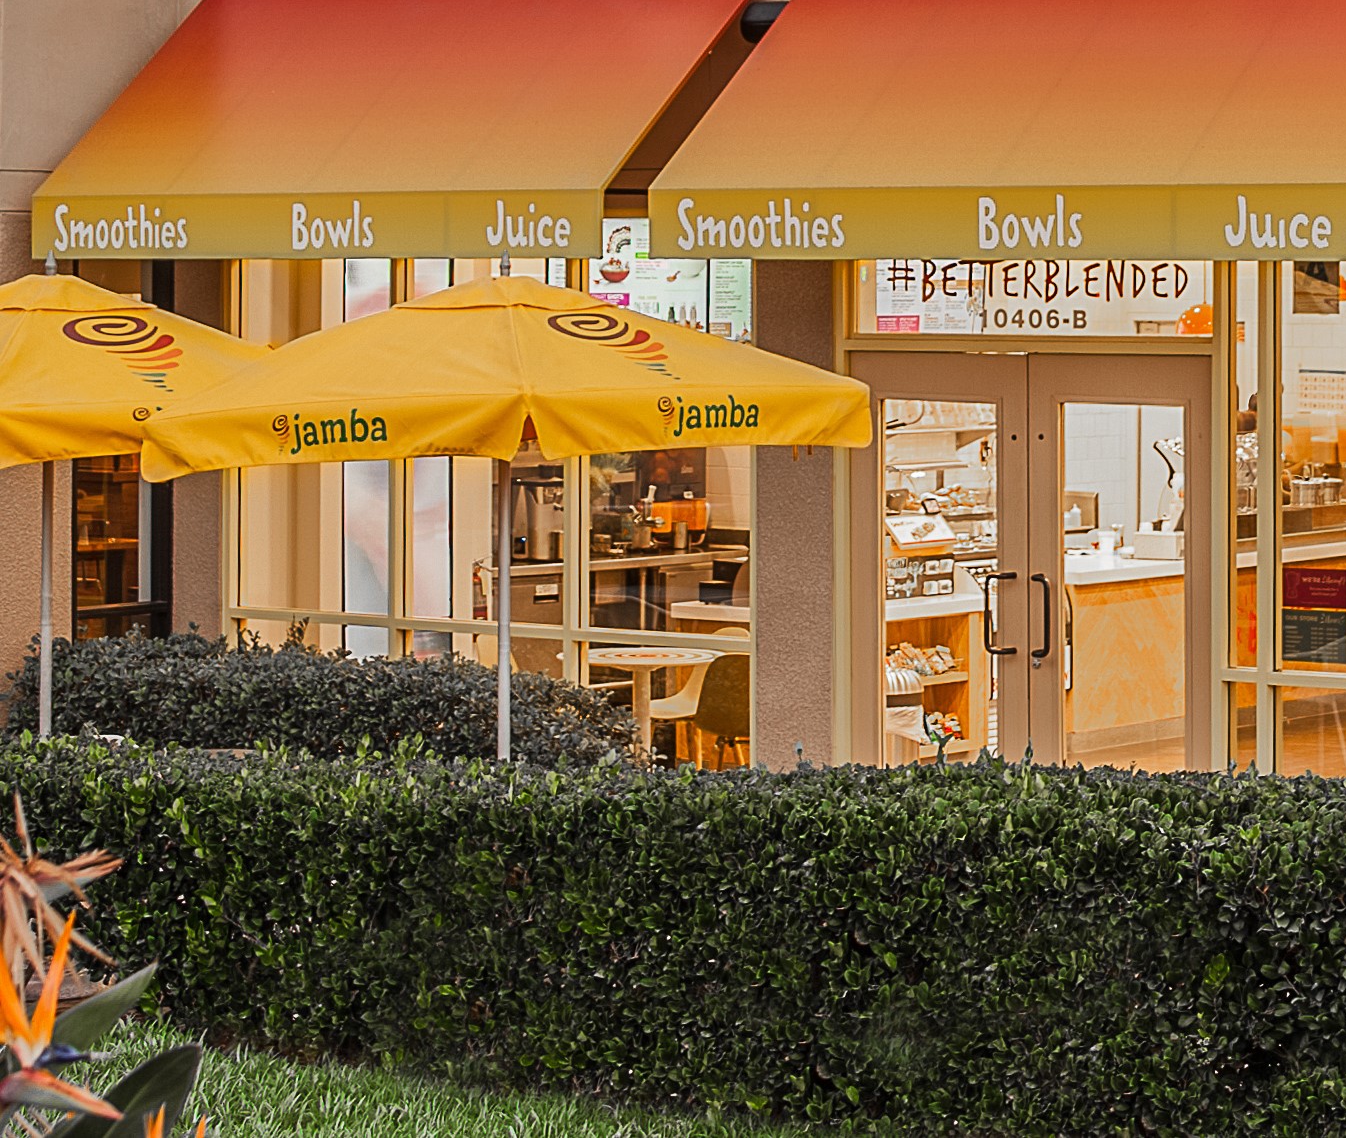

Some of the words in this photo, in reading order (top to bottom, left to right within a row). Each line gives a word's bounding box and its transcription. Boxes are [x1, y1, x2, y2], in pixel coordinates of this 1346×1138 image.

[54, 203, 188, 252] Smoothies
[291, 199, 374, 251] Bowls
[486, 199, 571, 248] Juice
[676, 197, 845, 251] Smoothies
[976, 194, 1083, 250] Bowls
[1224, 194, 1332, 250] Juice
[887, 259, 1189, 303] #BETTERBLENDED
[981, 308, 1088, 330] 10406-B
[290, 408, 388, 455] jamba
[674, 394, 760, 437] jamba
